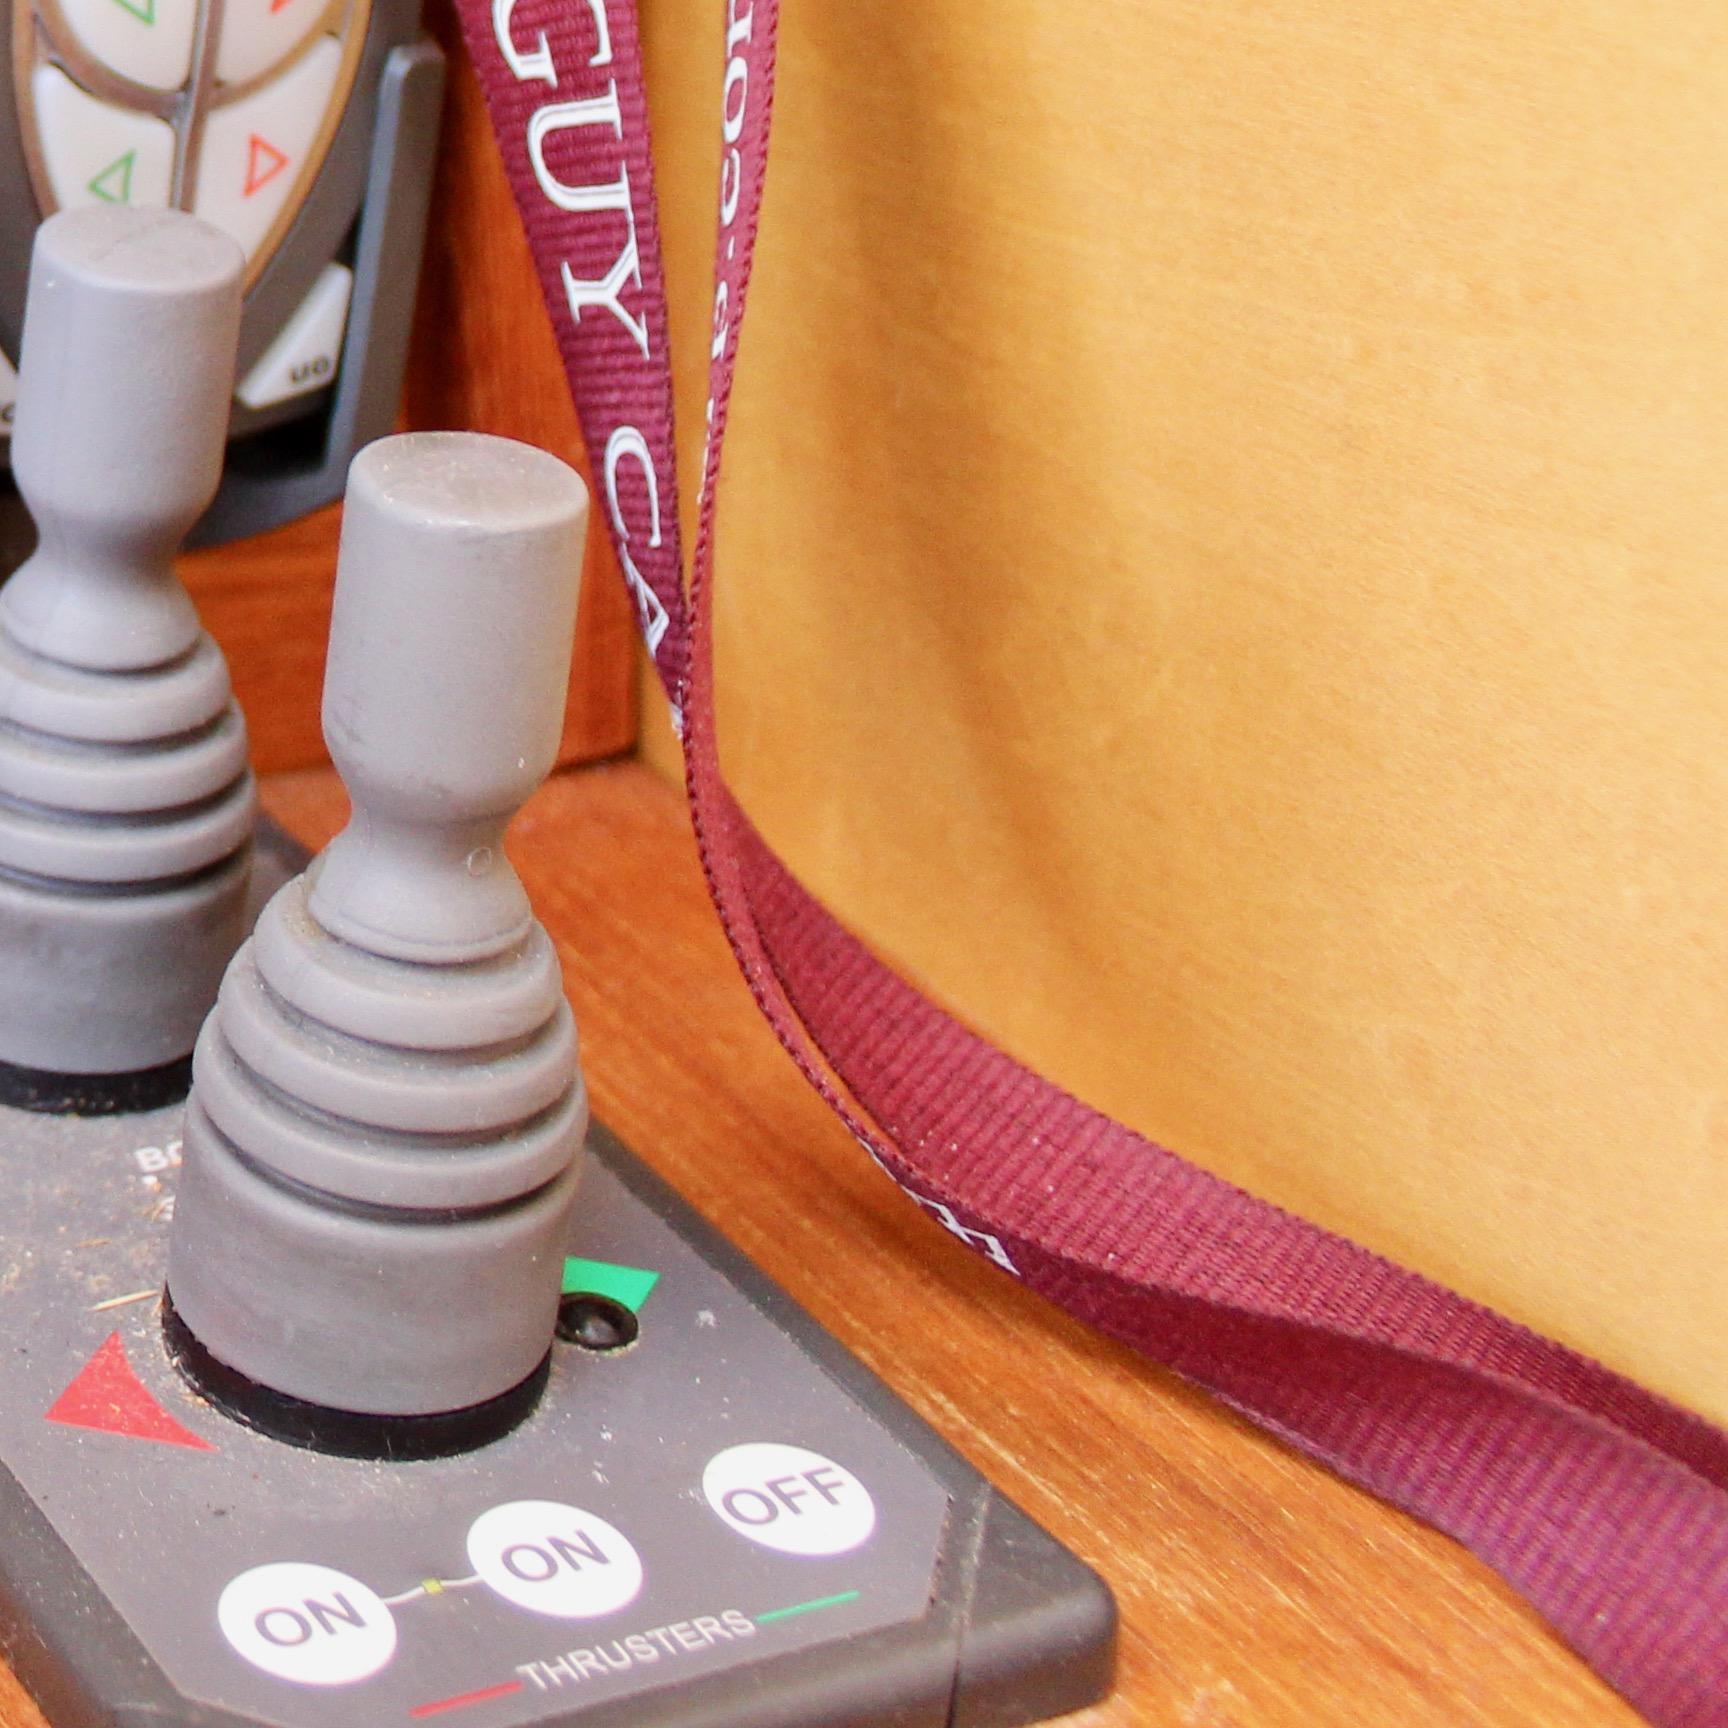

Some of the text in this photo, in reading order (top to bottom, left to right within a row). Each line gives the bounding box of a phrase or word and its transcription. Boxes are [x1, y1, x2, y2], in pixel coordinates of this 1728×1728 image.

[719, 1466, 849, 1527] OFF
[500, 1528, 610, 1586] ON
[253, 1590, 369, 1649] ON
[516, 1608, 757, 1694] THRUSTERS
